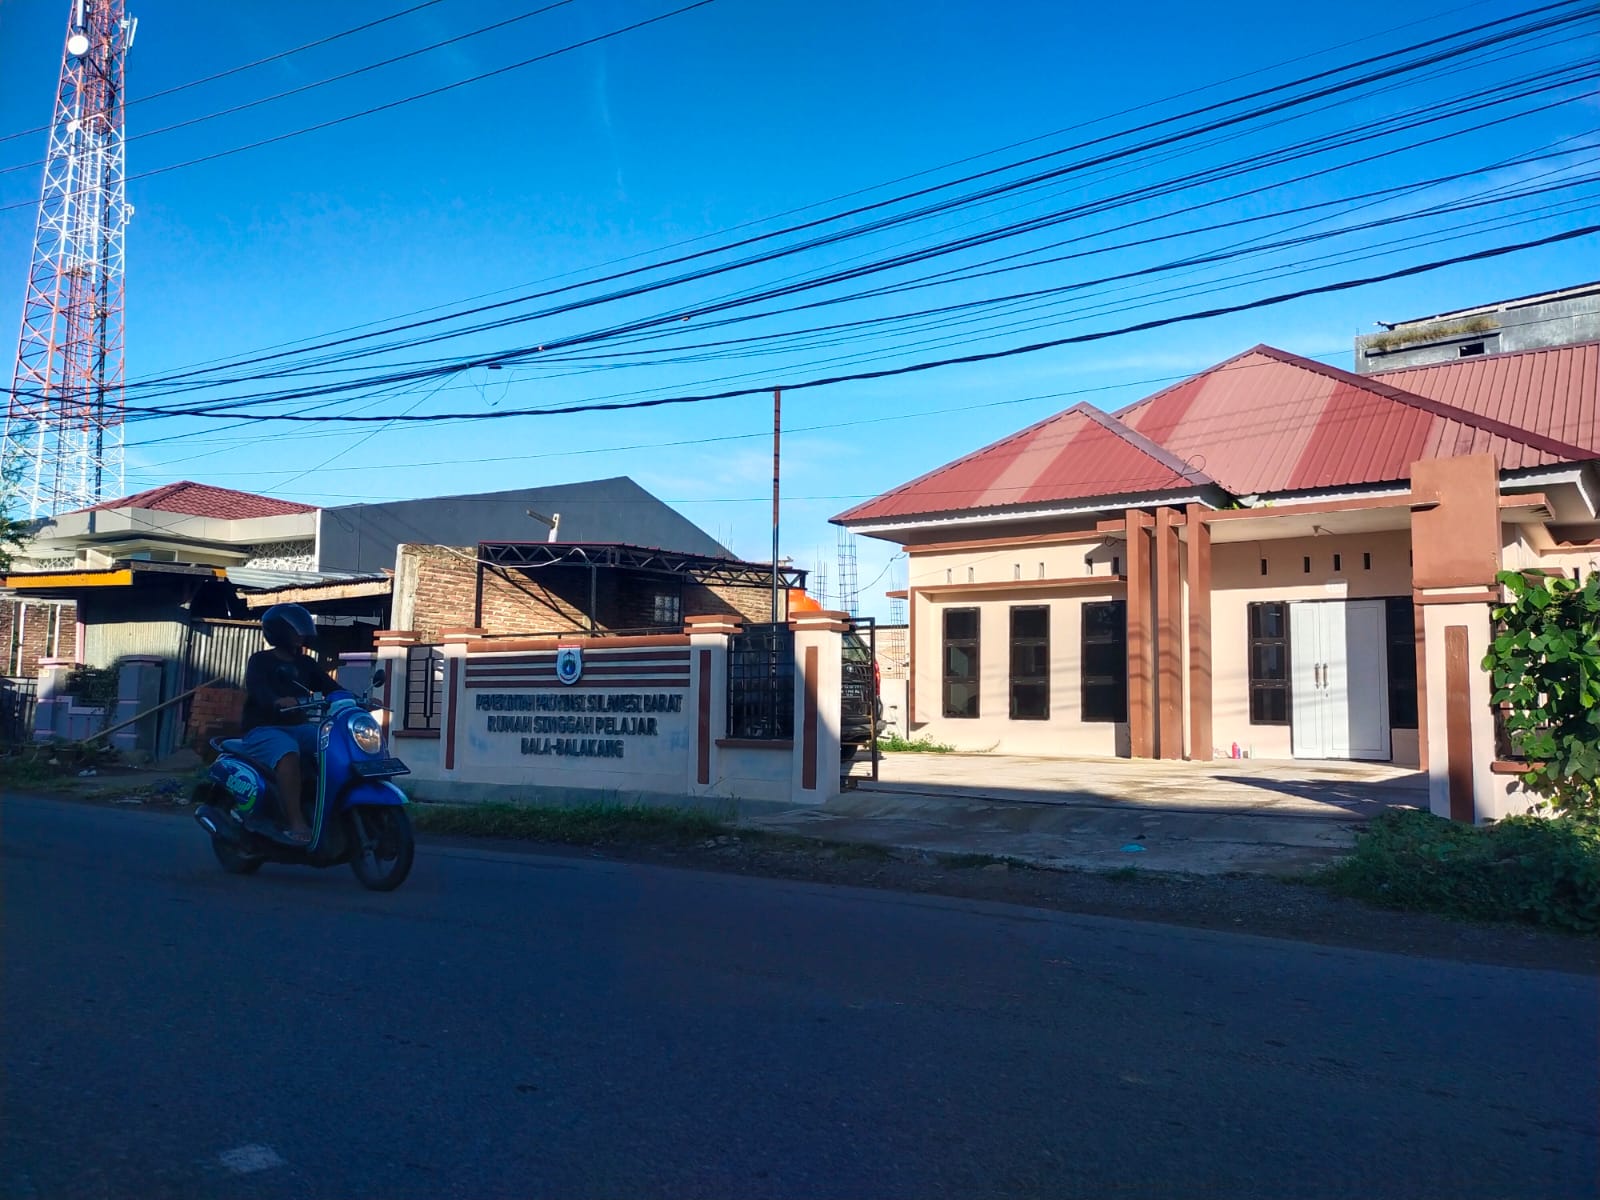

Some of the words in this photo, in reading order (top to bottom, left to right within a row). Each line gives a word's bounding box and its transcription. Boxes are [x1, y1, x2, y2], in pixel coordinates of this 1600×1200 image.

[644, 694, 683, 712] BARAT
[487, 715, 533, 733] RUMAH
[533, 715, 595, 734] SINGGAH
[595, 716, 658, 735] PELAJAR
